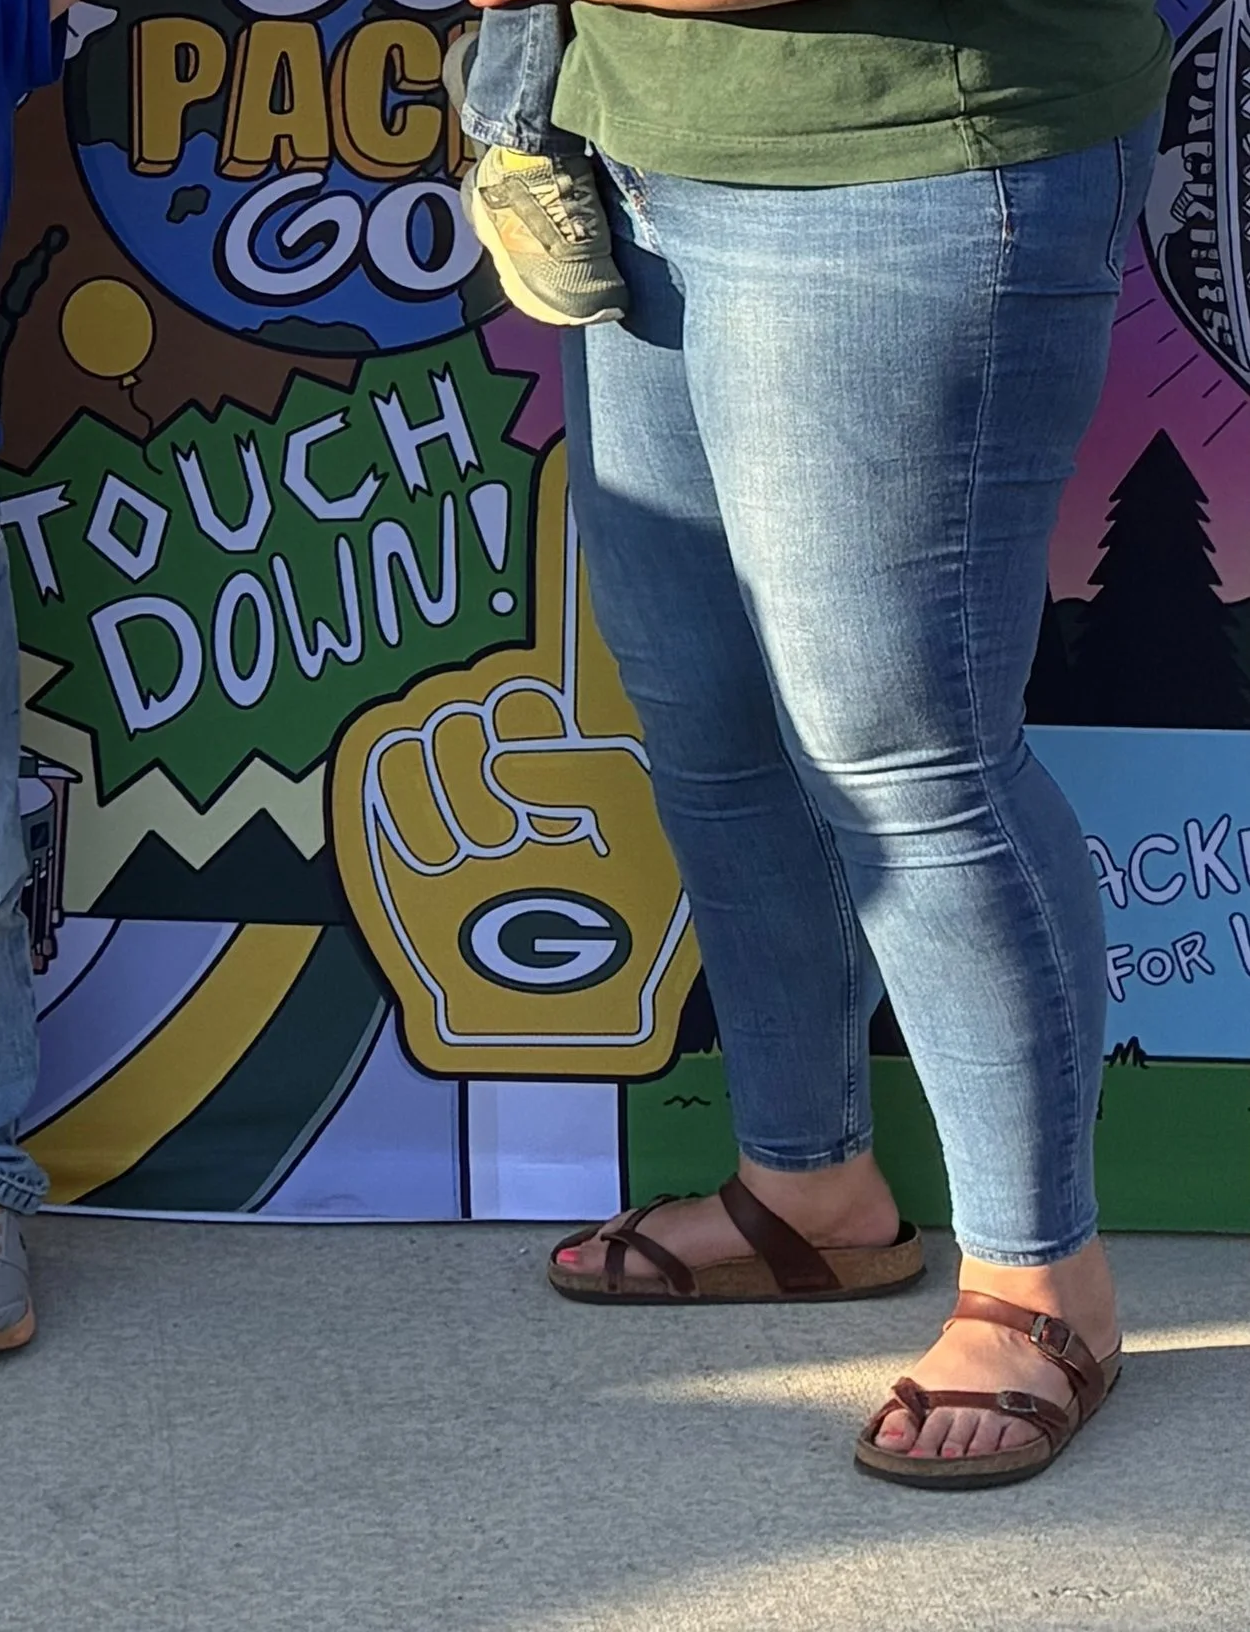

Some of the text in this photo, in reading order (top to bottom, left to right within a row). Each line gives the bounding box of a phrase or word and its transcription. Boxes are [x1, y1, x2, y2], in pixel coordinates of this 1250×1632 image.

[129, 12, 478, 181] PAC
[216, 171, 484, 304] GO
[88, 479, 517, 739] DOWN!
[1084, 813, 1250, 909] ACK
[1106, 930, 1216, 1003] FOR
